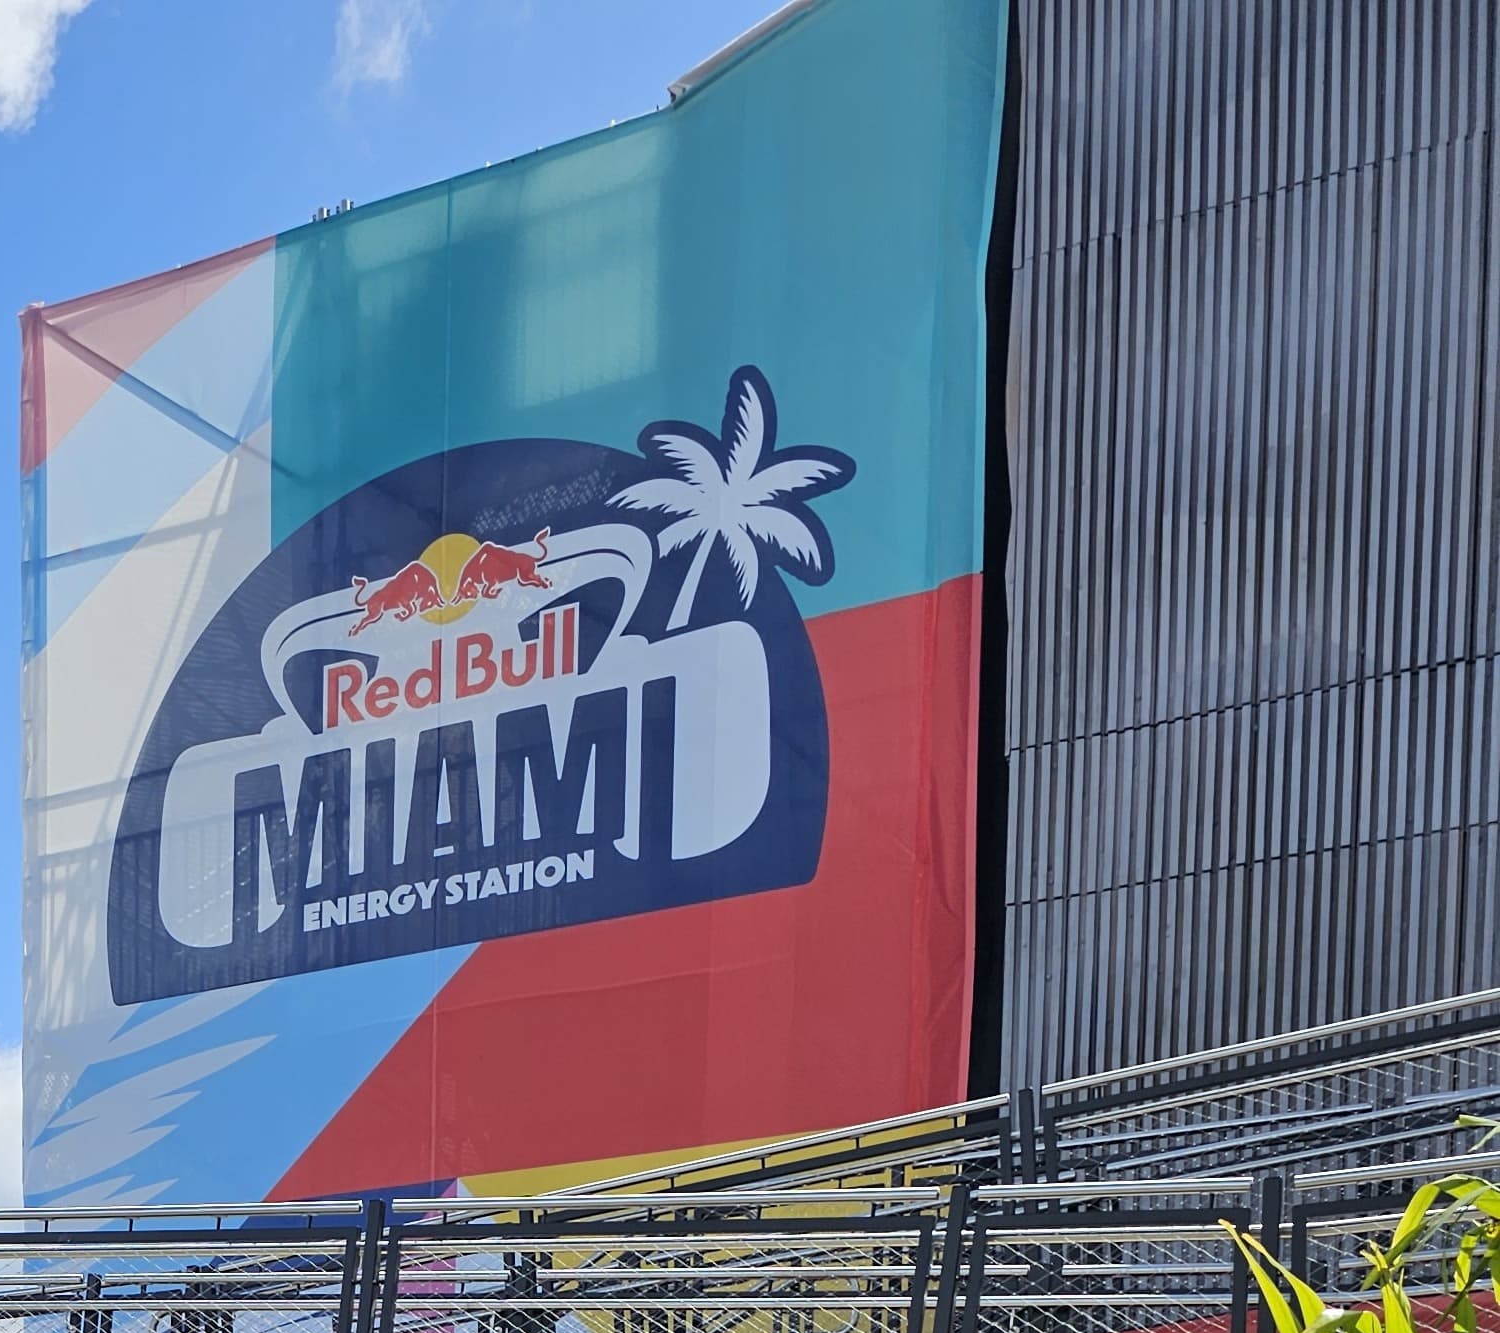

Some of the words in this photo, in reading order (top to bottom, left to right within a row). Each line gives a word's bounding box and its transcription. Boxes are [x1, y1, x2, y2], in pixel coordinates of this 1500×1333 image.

[326, 638, 442, 729] Red
[455, 607, 577, 699] Bull
[233, 675, 677, 925] MIAMI
[302, 881, 441, 933] ENERGY
[445, 850, 595, 906] STATION
